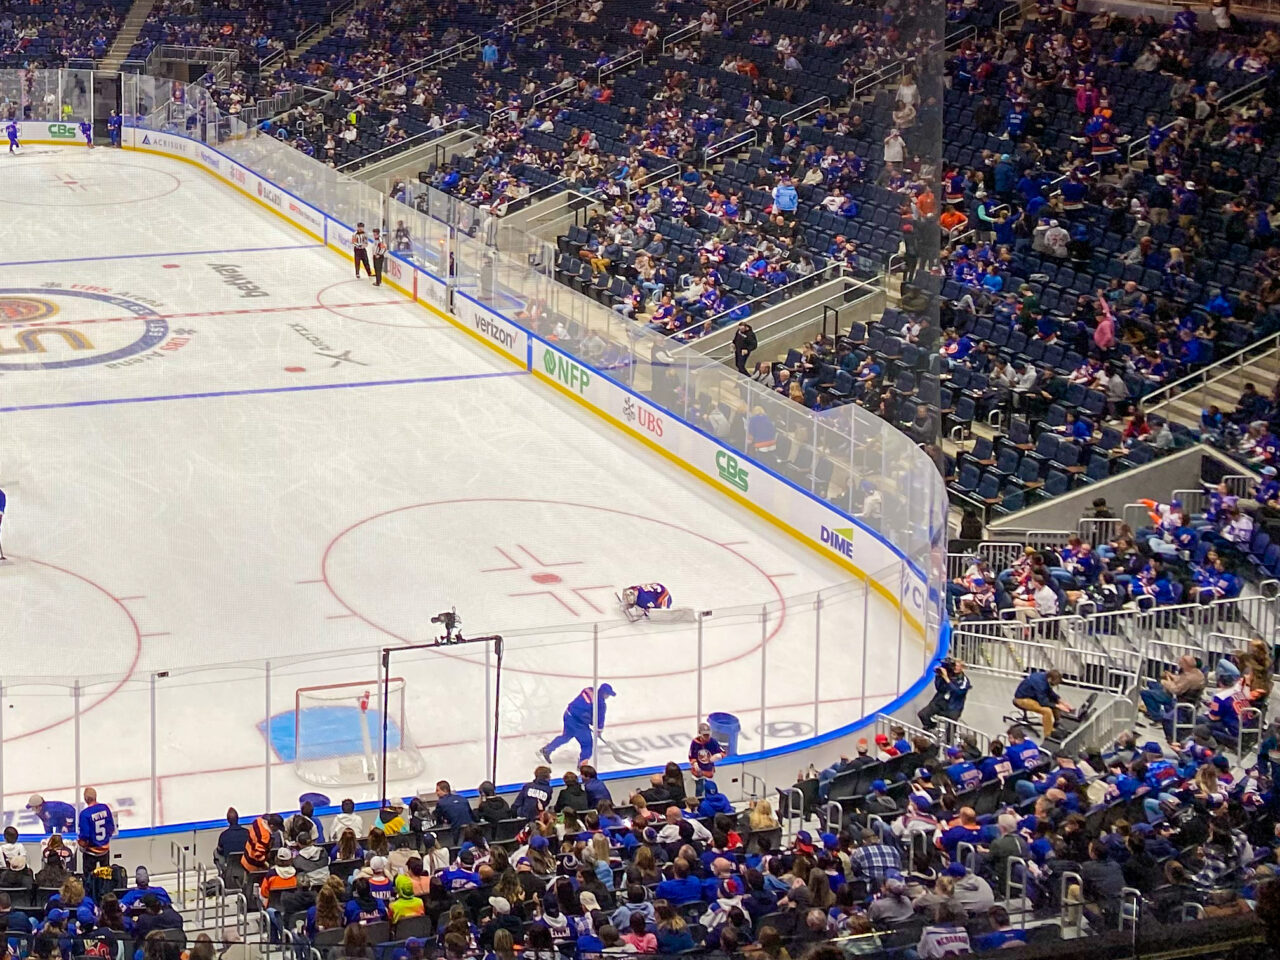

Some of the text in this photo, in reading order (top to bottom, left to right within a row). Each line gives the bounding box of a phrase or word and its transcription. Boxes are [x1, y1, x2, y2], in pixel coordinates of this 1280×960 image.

[474, 312, 513, 349] verizon
[558, 354, 590, 394] NFP
[637, 406, 664, 438] UBS
[820, 524, 854, 560] DIME
[527, 787, 548, 800] GUARD
[95, 820, 107, 841] 5
